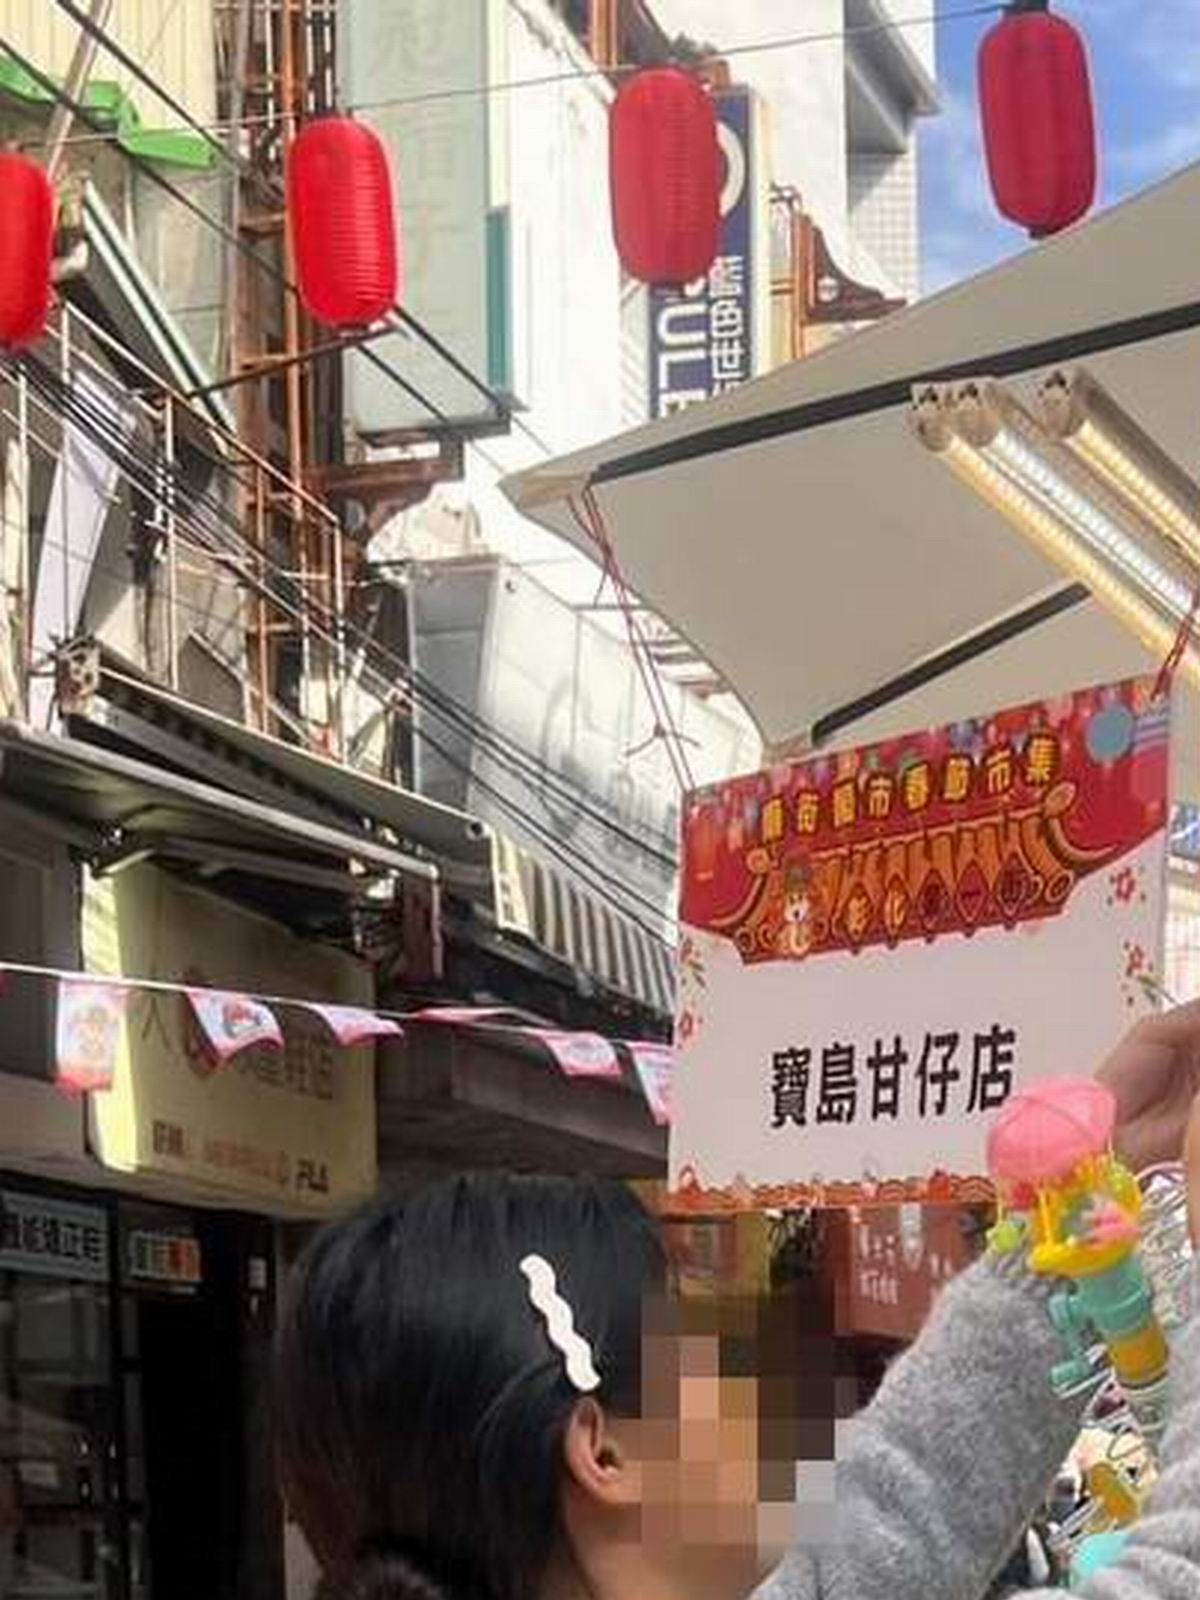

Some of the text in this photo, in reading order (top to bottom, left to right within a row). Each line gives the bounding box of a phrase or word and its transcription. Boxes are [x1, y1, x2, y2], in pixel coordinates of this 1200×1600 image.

[771, 1023, 1016, 1128] 寶島甘仔店
